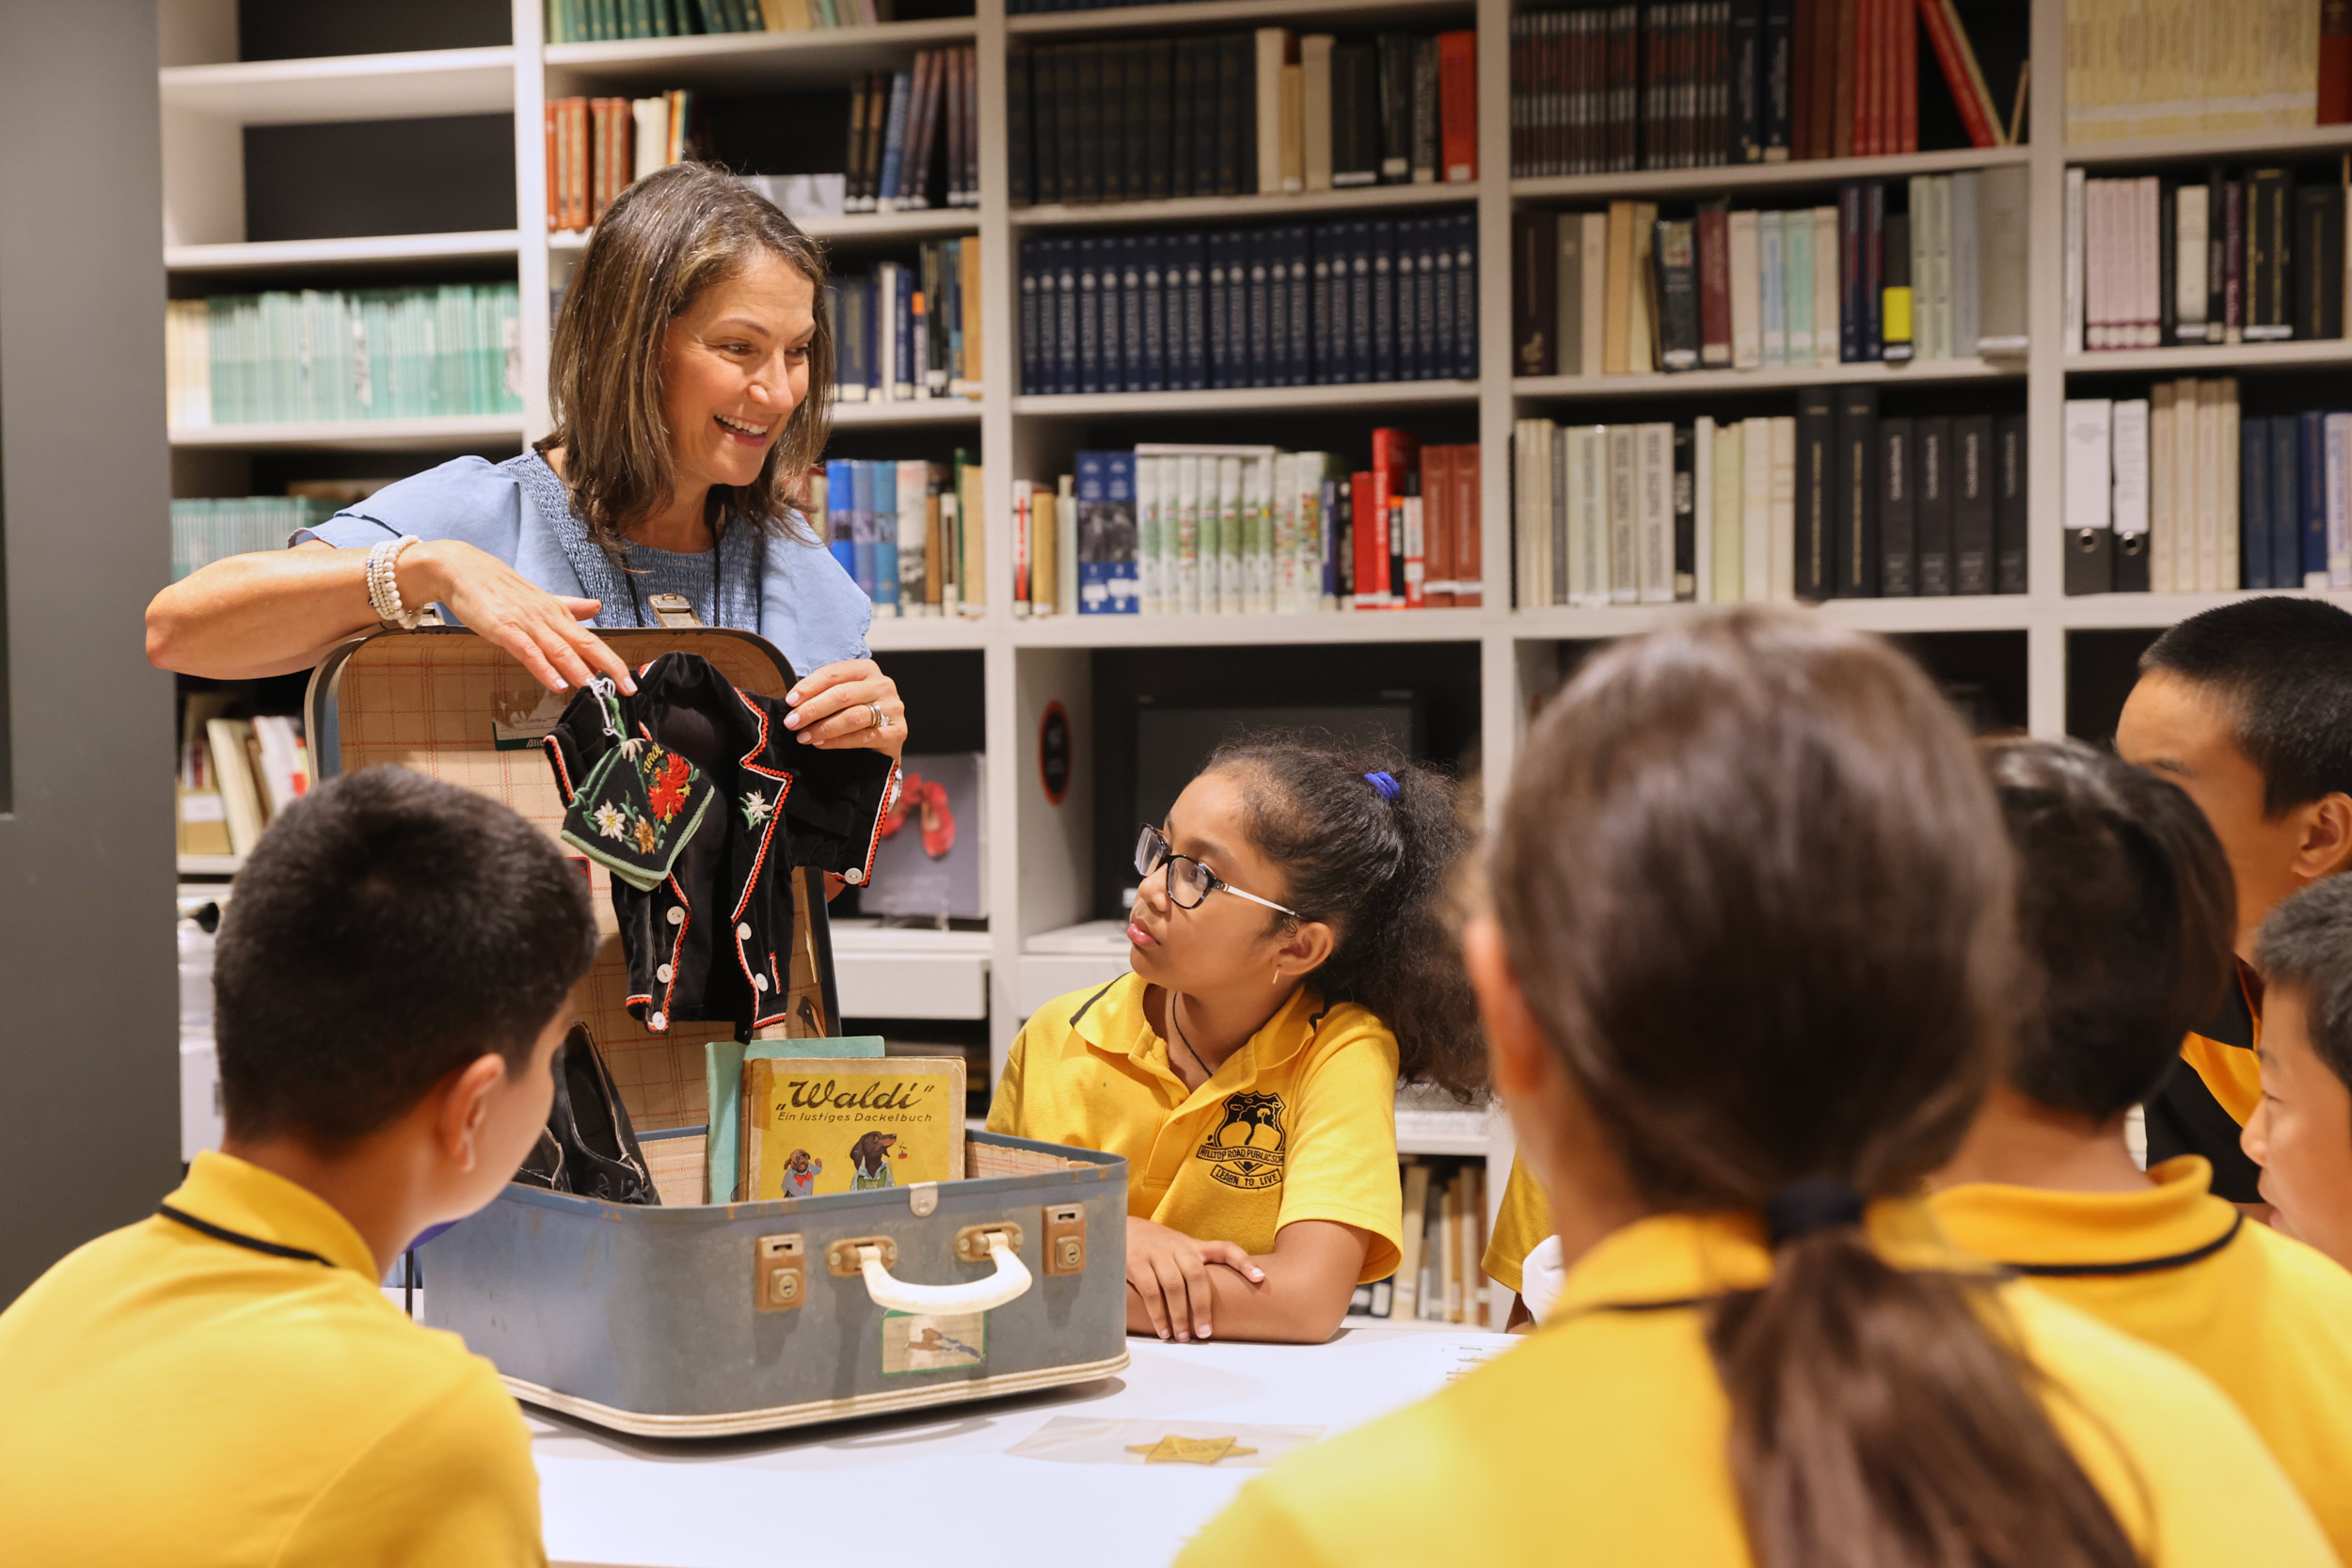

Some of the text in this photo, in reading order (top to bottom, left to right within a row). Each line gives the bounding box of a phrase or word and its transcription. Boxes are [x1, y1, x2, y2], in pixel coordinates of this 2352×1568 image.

[778, 1112, 932, 1123] Ein lustiges Dackelbuch
[1200, 1148, 1226, 1160] HILLTOP
[1228, 1149, 1246, 1158] ROAD
[1247, 1149, 1271, 1162] PUBLIC
[1216, 1169, 1278, 1186] LEARN TO LIVE
